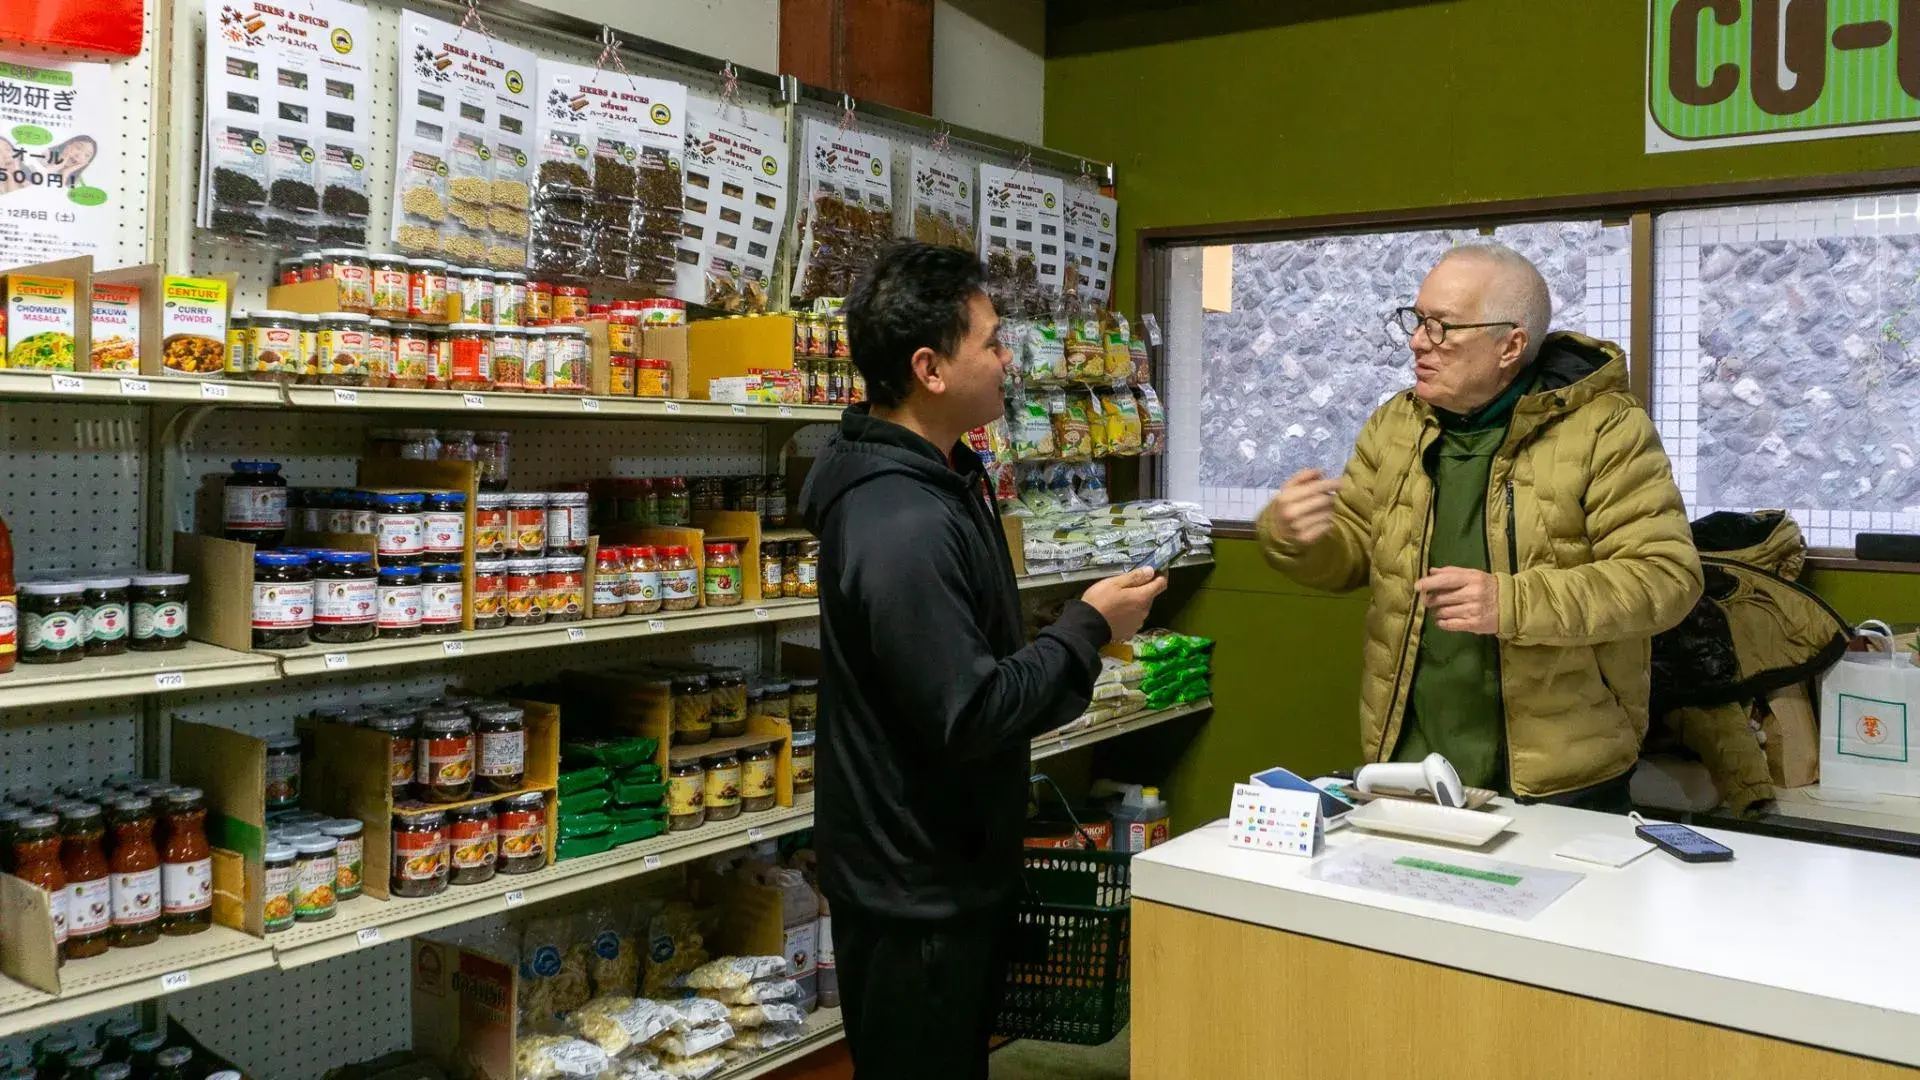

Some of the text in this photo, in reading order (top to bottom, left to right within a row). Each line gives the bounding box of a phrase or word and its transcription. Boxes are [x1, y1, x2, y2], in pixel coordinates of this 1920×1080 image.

[254, 2, 329, 28] HERBS & SPICES
[580, 85, 650, 104] HERBS & SPICES
[12, 147, 64, 165] オール
[16, 285, 65, 296] CENTURY
[168, 287, 219, 298] CENTURY
[92, 293, 130, 302] ENTURY
[16, 304, 67, 315] CHOWMEIN
[178, 305, 208, 315] CURRY
[23, 313, 61, 323] MASALA
[92, 315, 128, 324] MASALA
[173, 313, 212, 324] POWDER
